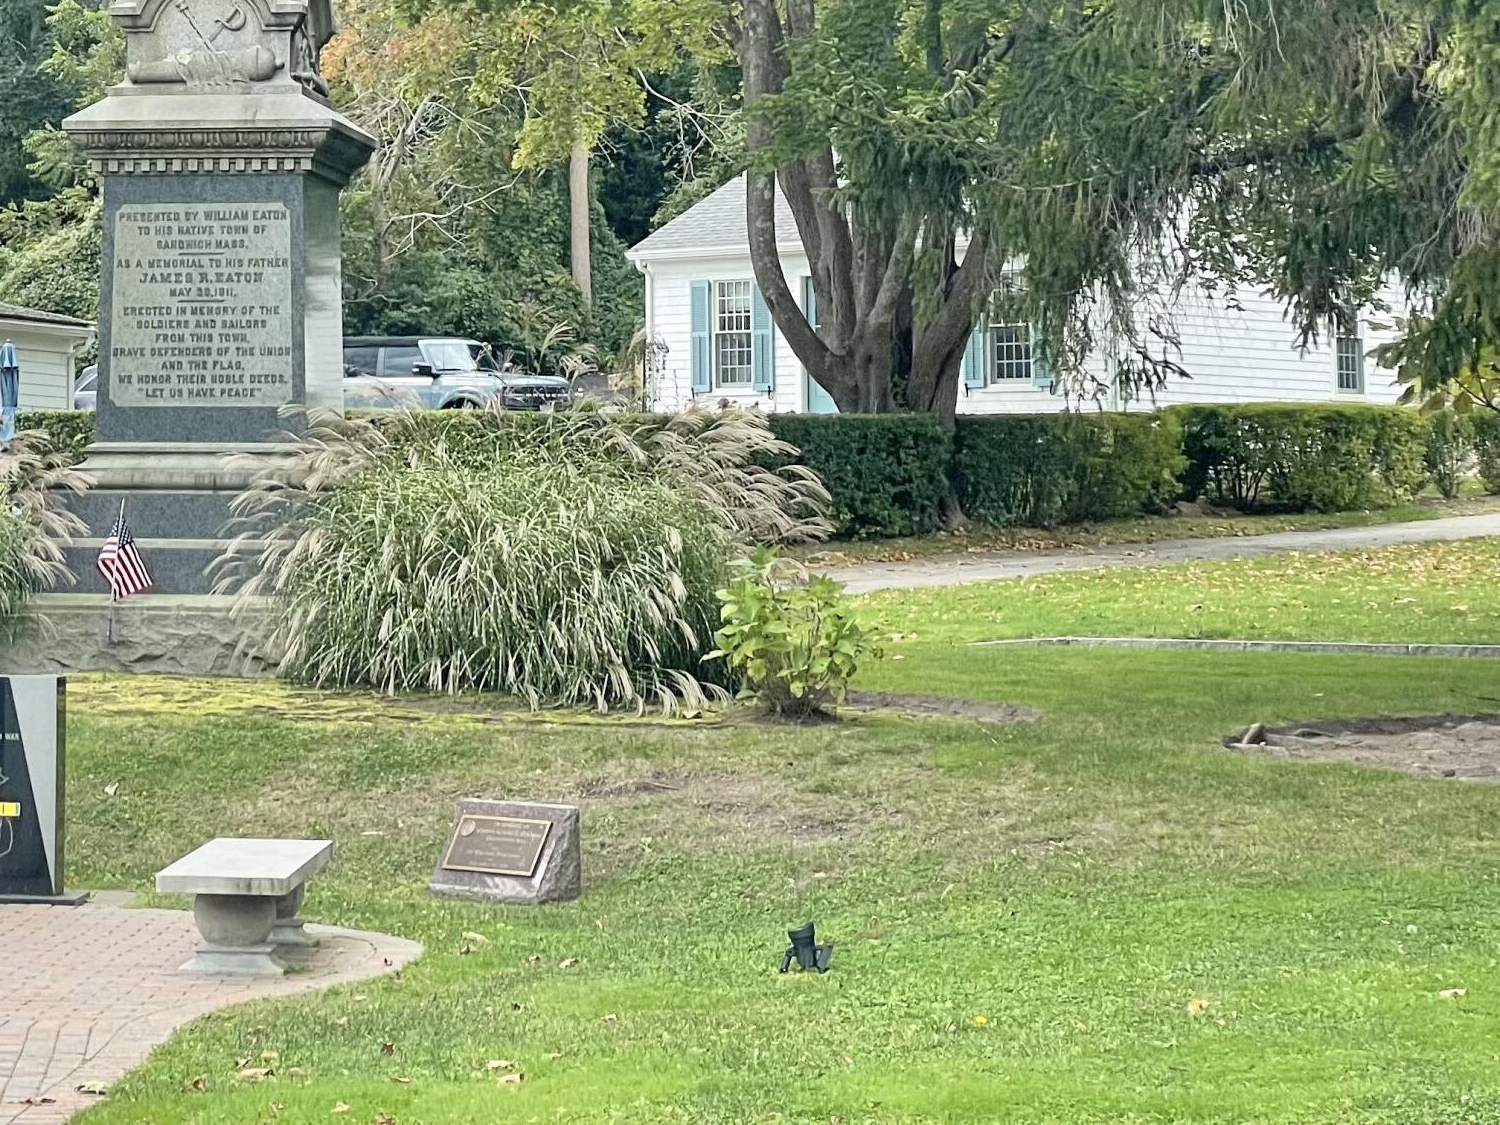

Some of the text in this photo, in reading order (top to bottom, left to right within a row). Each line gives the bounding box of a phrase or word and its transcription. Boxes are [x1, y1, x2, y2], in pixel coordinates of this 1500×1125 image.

[117, 210, 181, 222] PRESENTED
[203, 210, 249, 222] WILLIAM
[252, 210, 288, 222] EATON
[137, 224, 268, 236] TO HIS NATIVE TOWN OF
[156, 239, 212, 250] SANDWICH
[116, 257, 289, 269] AS A MEMORIAL TO HIS FATHER
[139, 271, 194, 284] JAMES
[169, 286, 193, 299] MAY
[122, 305, 281, 317] ERECTED IN MEMORY OF THE
[135, 319, 267, 330] SOLDIERS AND SAILORS
[155, 332, 185, 344] FROM
[189, 332, 214, 344] THIS
[112, 346, 291, 357] BRAVE DEFENDERS OF THE UNION
[160, 359, 184, 371] AND
[187, 359, 208, 371] THE
[117, 373, 289, 385] WE HONOR THEIR NOBLE DEEDS.
[169, 387, 184, 399] US
[187, 387, 216, 399] HAVE
[4, 732, 20, 741] WAR
